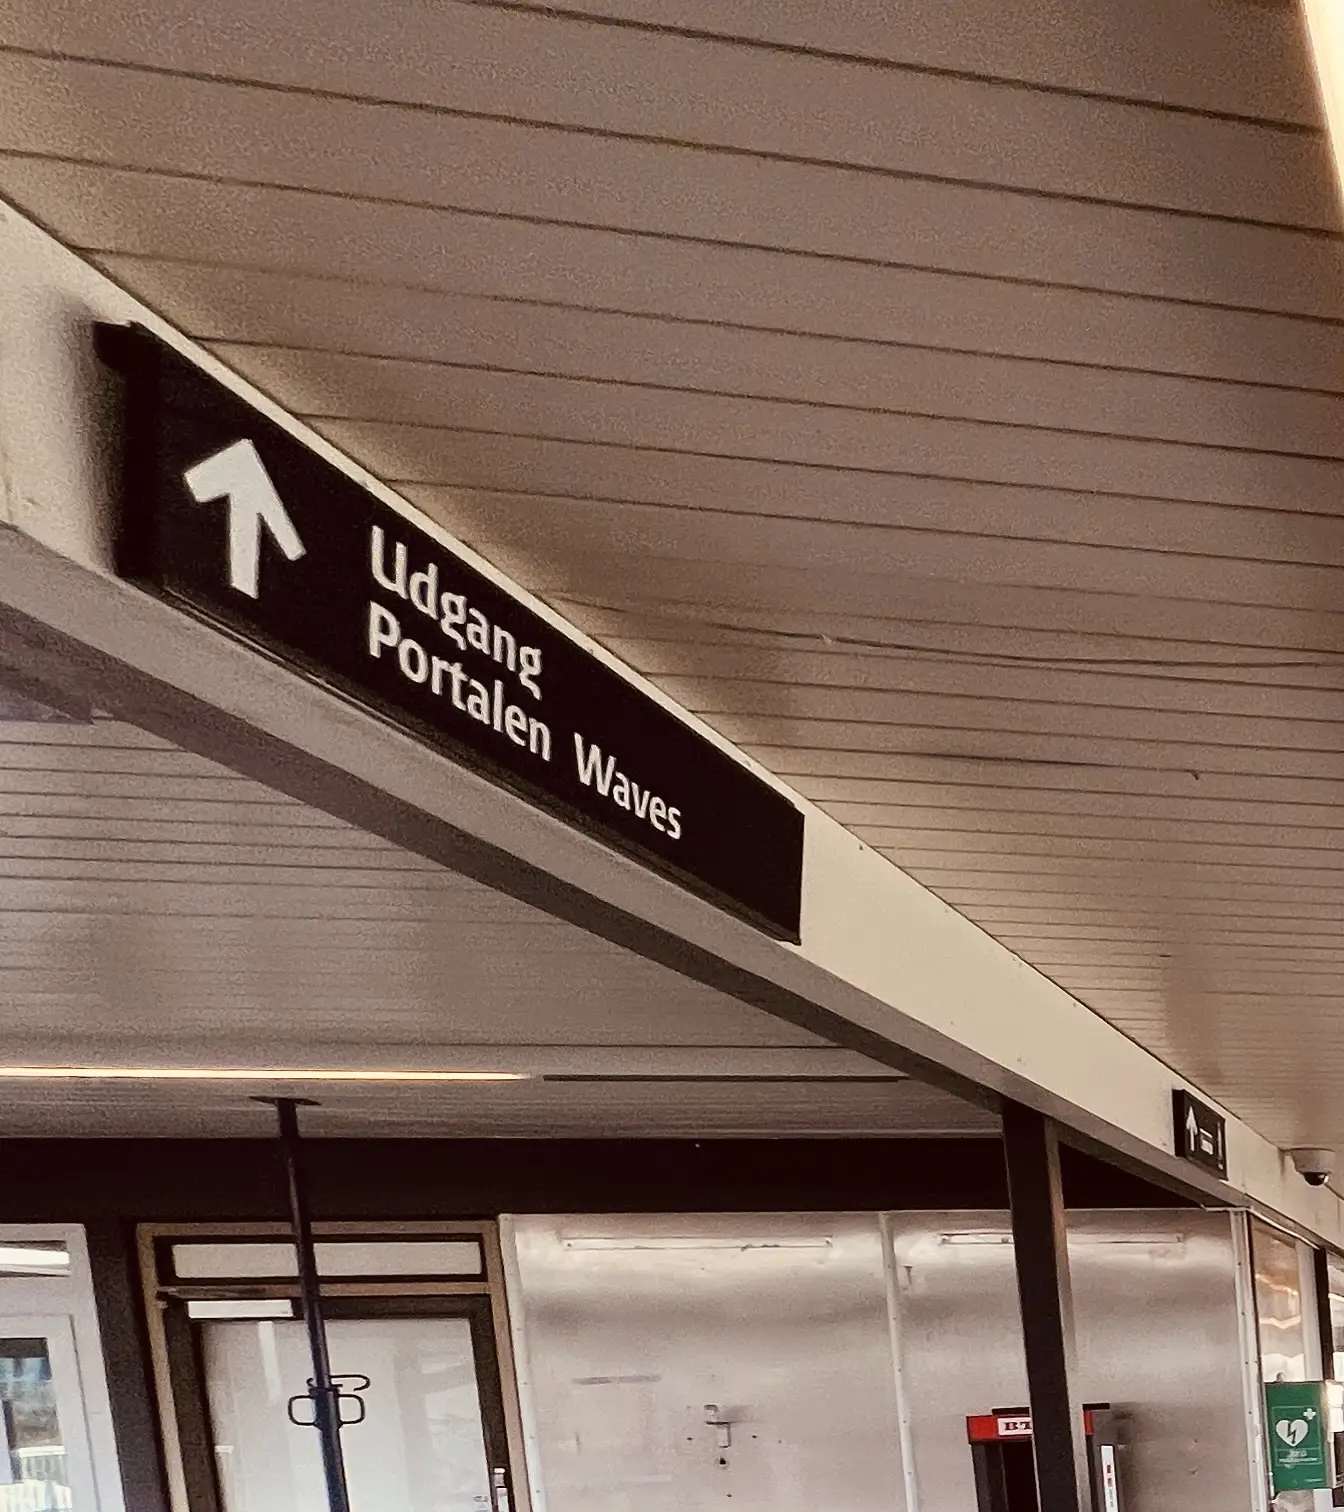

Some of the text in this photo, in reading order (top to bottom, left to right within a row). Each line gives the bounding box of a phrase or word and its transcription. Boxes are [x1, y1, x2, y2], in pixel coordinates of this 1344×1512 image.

[372, 525, 542, 700] Udgang
[369, 601, 682, 840] Portalen Waves
